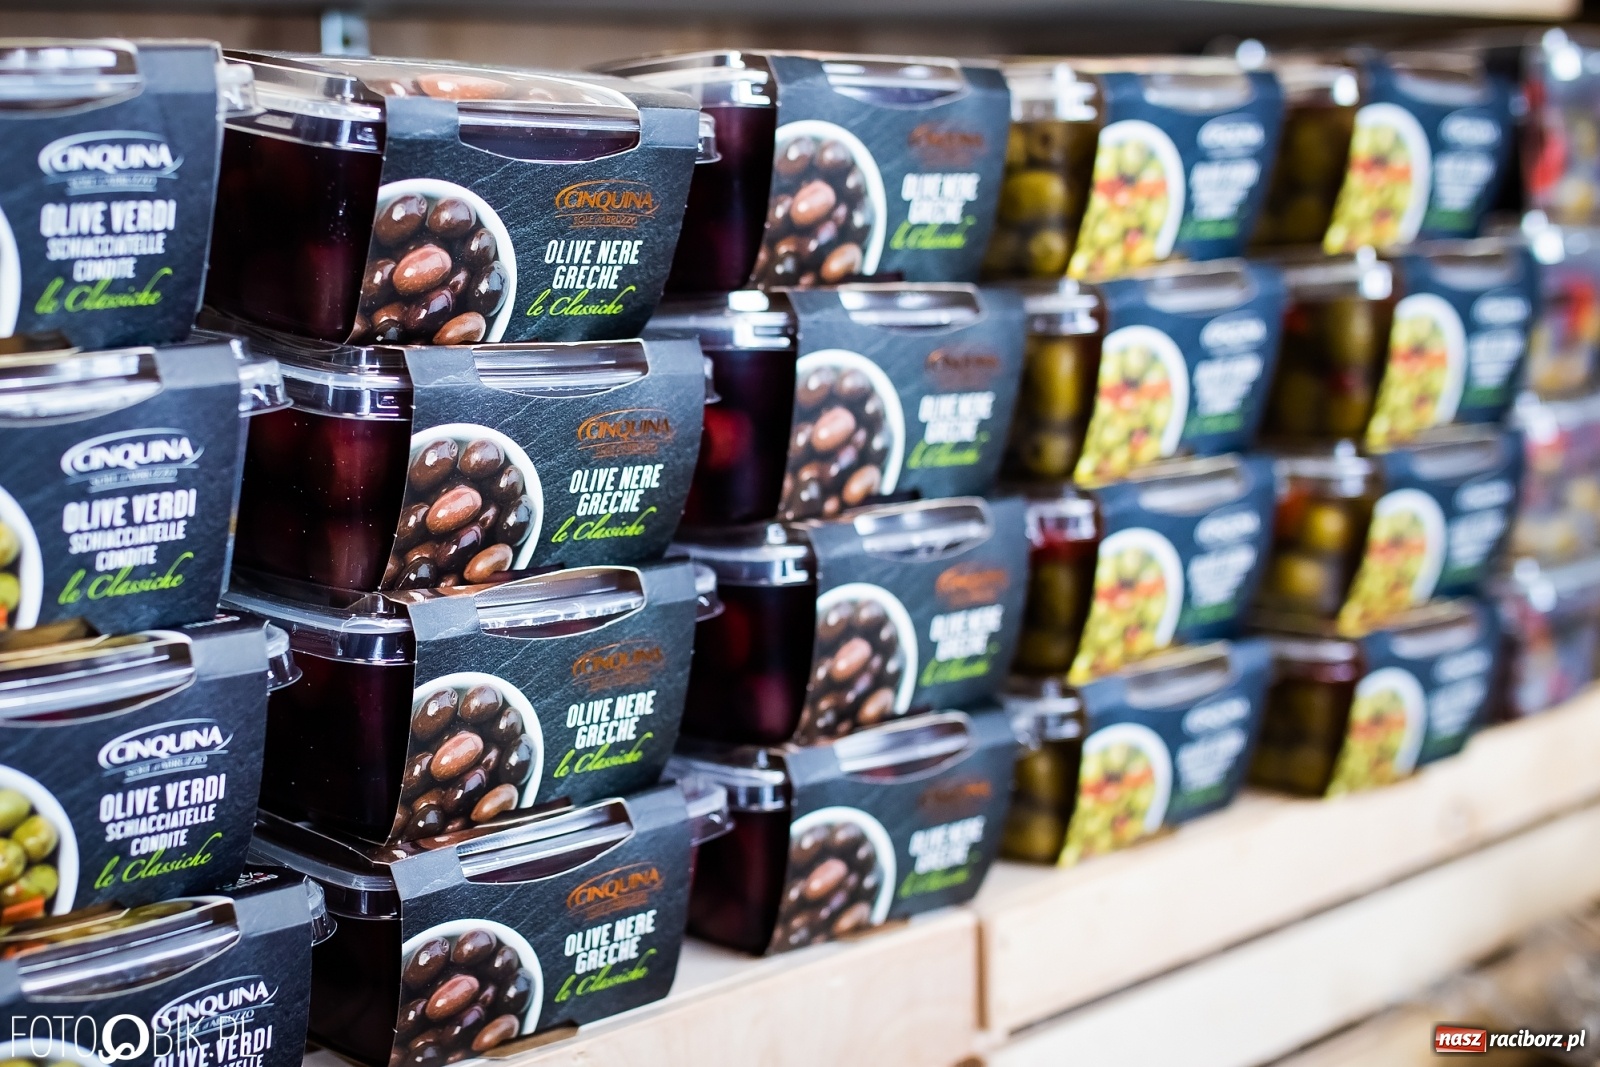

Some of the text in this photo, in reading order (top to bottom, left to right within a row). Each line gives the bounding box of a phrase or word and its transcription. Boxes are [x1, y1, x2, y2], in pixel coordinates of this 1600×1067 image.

[51, 142, 174, 174] CINQUINA
[40, 199, 177, 238] OLIVE VERDI
[563, 189, 653, 213] CINQUINA
[544, 239, 643, 265] OLIVE NERE
[552, 265, 623, 290] GRECHE
[526, 285, 637, 317] le Classiche
[585, 416, 670, 440] CINQUINA
[72, 436, 196, 472] CINQUINA
[569, 463, 665, 494] OLIVE NERE
[62, 488, 198, 534] OLIVE VERDI
[576, 489, 645, 517] GRECHE
[550, 506, 658, 543] le Classiche
[87, 551, 194, 601] Classiche
[566, 690, 657, 729] OLIVE NERE
[108, 725, 224, 765] CINQUINA
[575, 716, 640, 750] GRECHE
[99, 774, 227, 823] OLIVE VERDI
[105, 803, 217, 843] SCHIACCIATELLE
[93, 855, 121, 890] le
[121, 832, 223, 884] Classiche
[130, 829, 189, 857] CONDITE
[574, 867, 661, 906] CINQUINA
[564, 909, 658, 957] OLIVE NERE
[574, 935, 642, 975] GRECHE
[160, 981, 270, 1028] CINQUINA
[216, 1024, 273, 1064] VERDI
